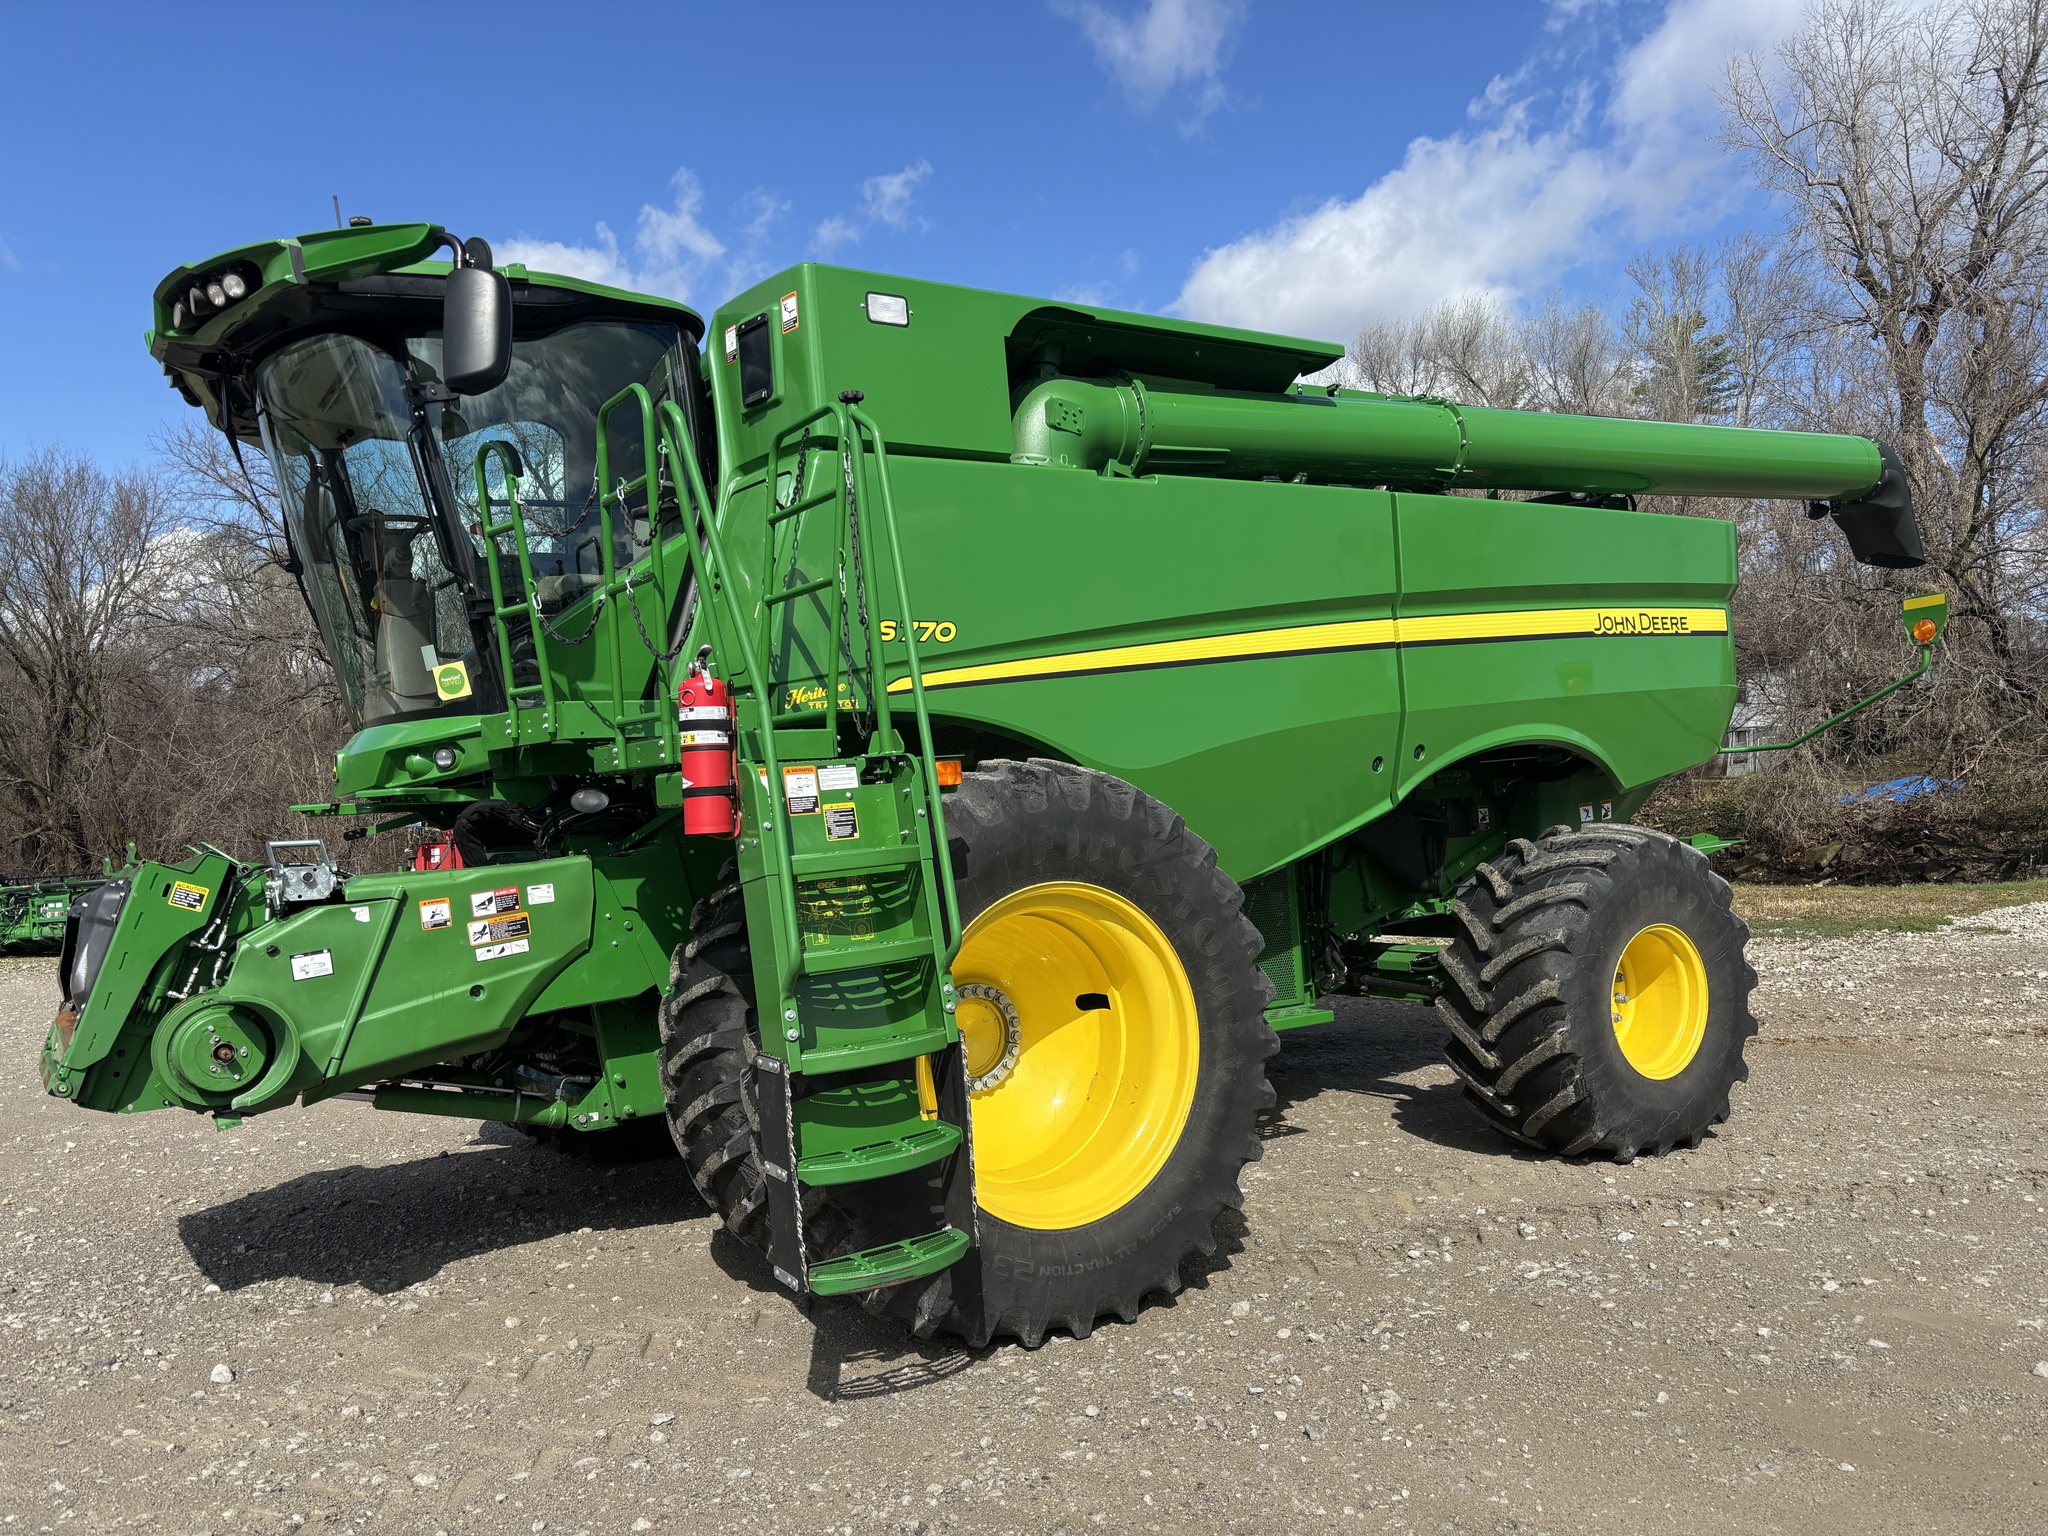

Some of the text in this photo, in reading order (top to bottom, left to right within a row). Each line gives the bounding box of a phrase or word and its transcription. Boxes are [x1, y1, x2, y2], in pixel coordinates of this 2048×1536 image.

[1594, 613, 1689, 631] JOHN DEERE
[785, 683, 846, 709] Heritae
[181, 883, 208, 894] CAUTION
[1038, 1255, 1114, 1278] TRACTION
